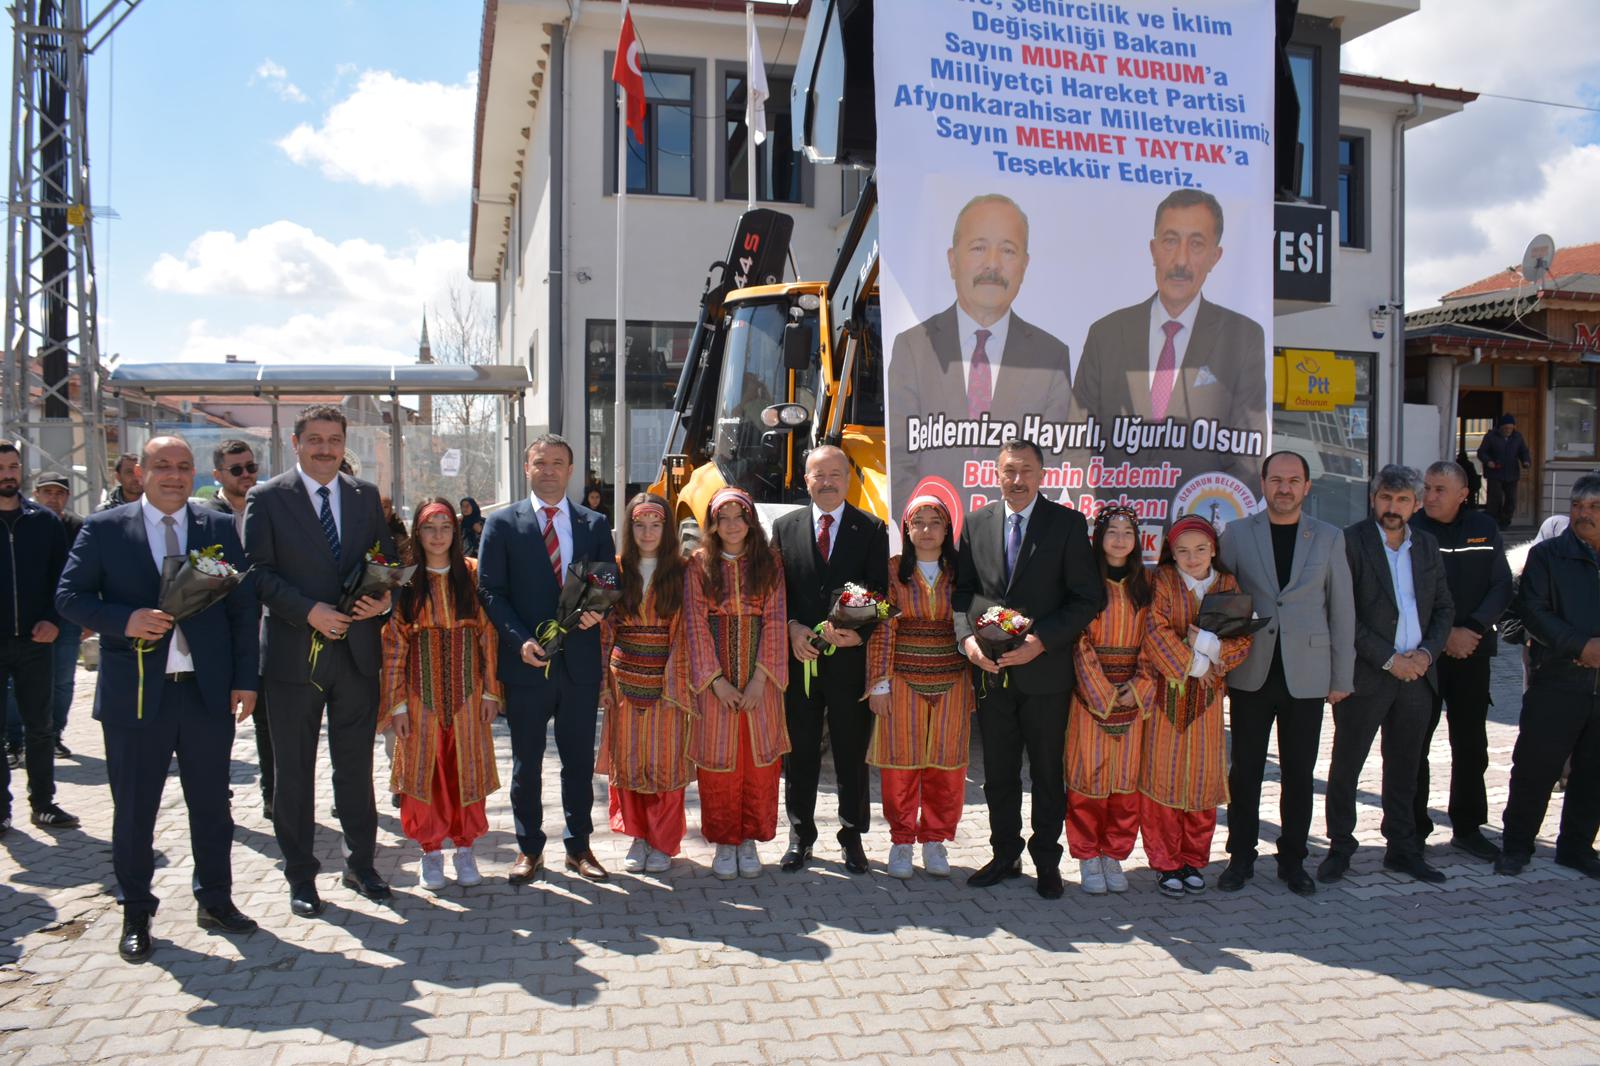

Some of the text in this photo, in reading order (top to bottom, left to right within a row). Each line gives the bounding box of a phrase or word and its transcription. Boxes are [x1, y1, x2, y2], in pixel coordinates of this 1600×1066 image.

[972, 10, 1197, 58] Değişikliği Bakanı
[1012, 0, 1233, 36] Şehircilik ve İklim
[945, 32, 1013, 64] Sayın
[1021, 45, 1108, 75] MURAT
[930, 58, 1246, 114] Milliyetçi Hareket Partisi
[893, 84, 1271, 147] Afyonkarahisar Milletvekilimiz
[936, 115, 1008, 148] Sayın
[1015, 125, 1127, 156] MEHMET
[993, 150, 1203, 188] Teşekkür Ederiz.
[1276, 223, 1324, 274] ESİ
[1308, 375, 1330, 395] Ptt
[907, 413, 1263, 456] Beldemize Hayırlı, Uğurlu Olsun
[1088, 456, 1181, 488] Özdemir
[1178, 475, 1255, 510] ÖZBURUN BELEDİYESİ
